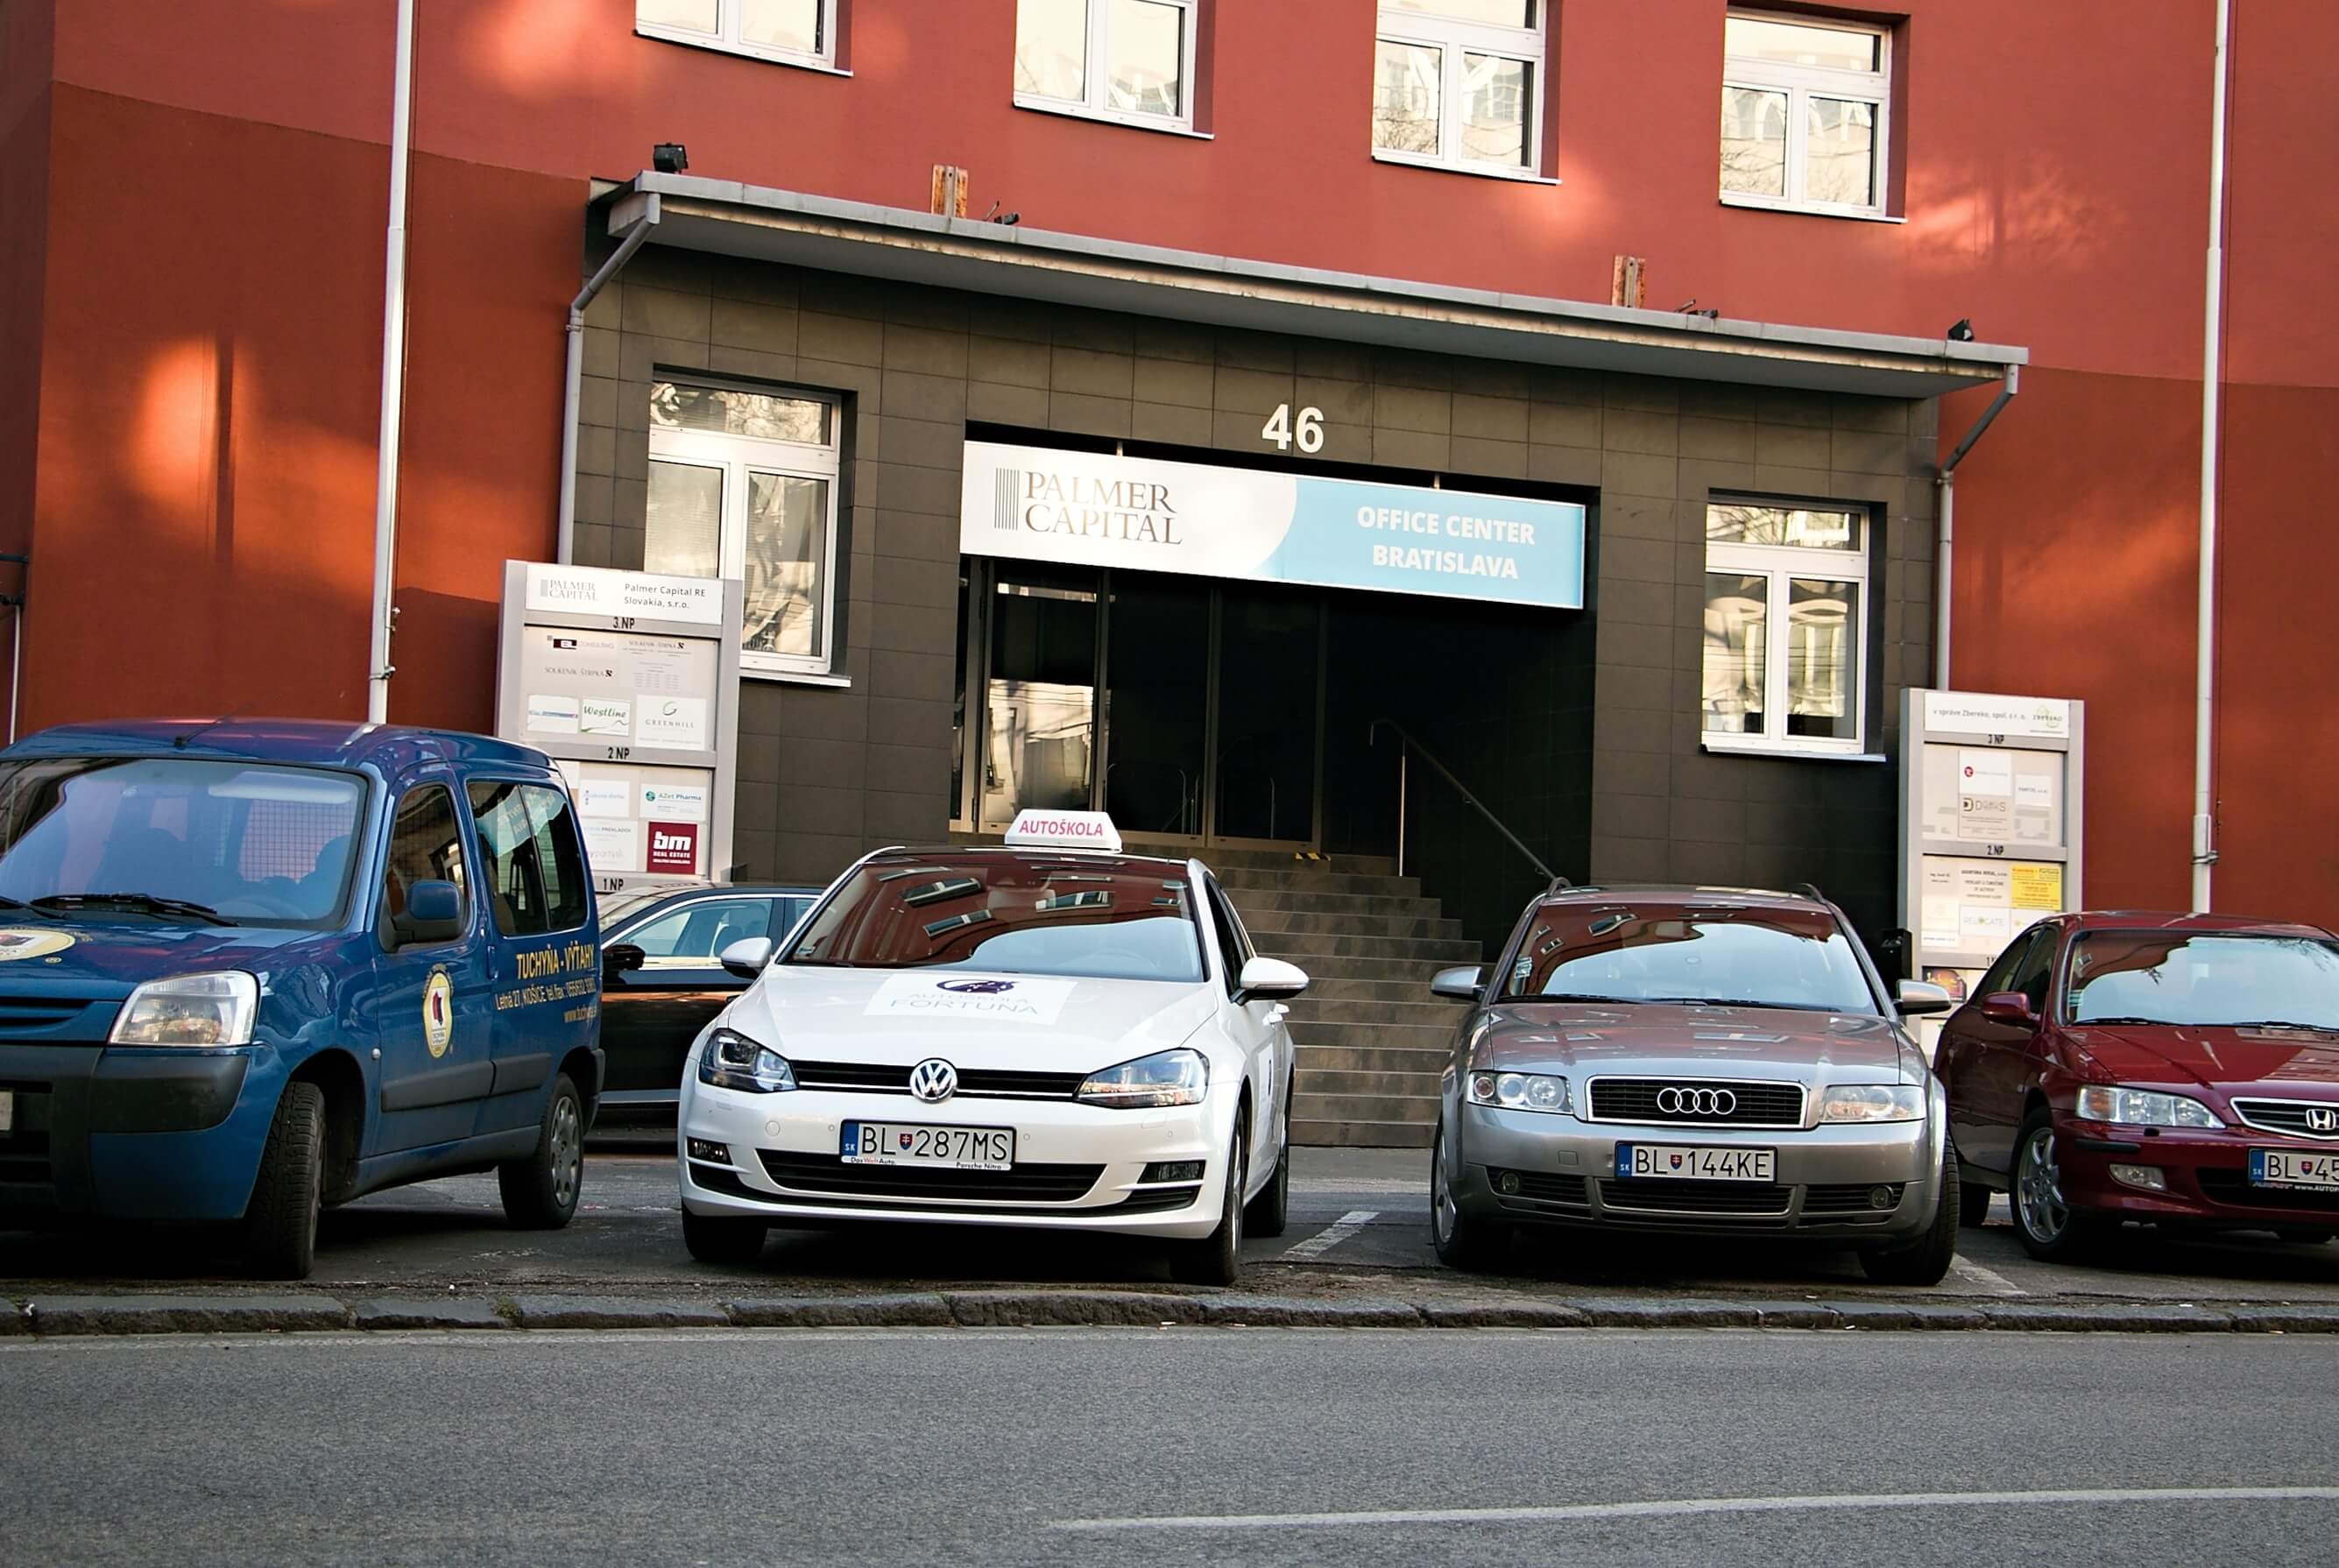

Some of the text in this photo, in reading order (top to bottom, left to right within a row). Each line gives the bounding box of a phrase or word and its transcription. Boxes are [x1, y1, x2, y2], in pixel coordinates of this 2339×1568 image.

[1261, 404, 1325, 453] 46
[1024, 470, 1177, 513] PALMER
[1024, 503, 1183, 545] CAPITAL
[1357, 505, 1535, 545] OFFICE CENTER
[1373, 544, 1519, 580] BRATISLAVA
[549, 579, 596, 592] PALMER
[549, 589, 598, 601] CAPITAL
[625, 583, 706, 597] Palmer Capital RE
[624, 597, 690, 609] Slovakia, s.r.o.
[583, 706, 626, 718] Westline
[645, 719, 695, 729] GREENHILL
[1020, 819, 1103, 836] AUTOŠKOLA
[654, 831, 691, 851] bm
[890, 999, 1038, 1015] FORTUNA
[861, 1127, 896, 1155] BL
[914, 1128, 1008, 1161] 287MS
[1636, 1148, 1668, 1175] BL
[1687, 1150, 1770, 1178] 144KE
[2268, 1155, 2299, 1179] BL
